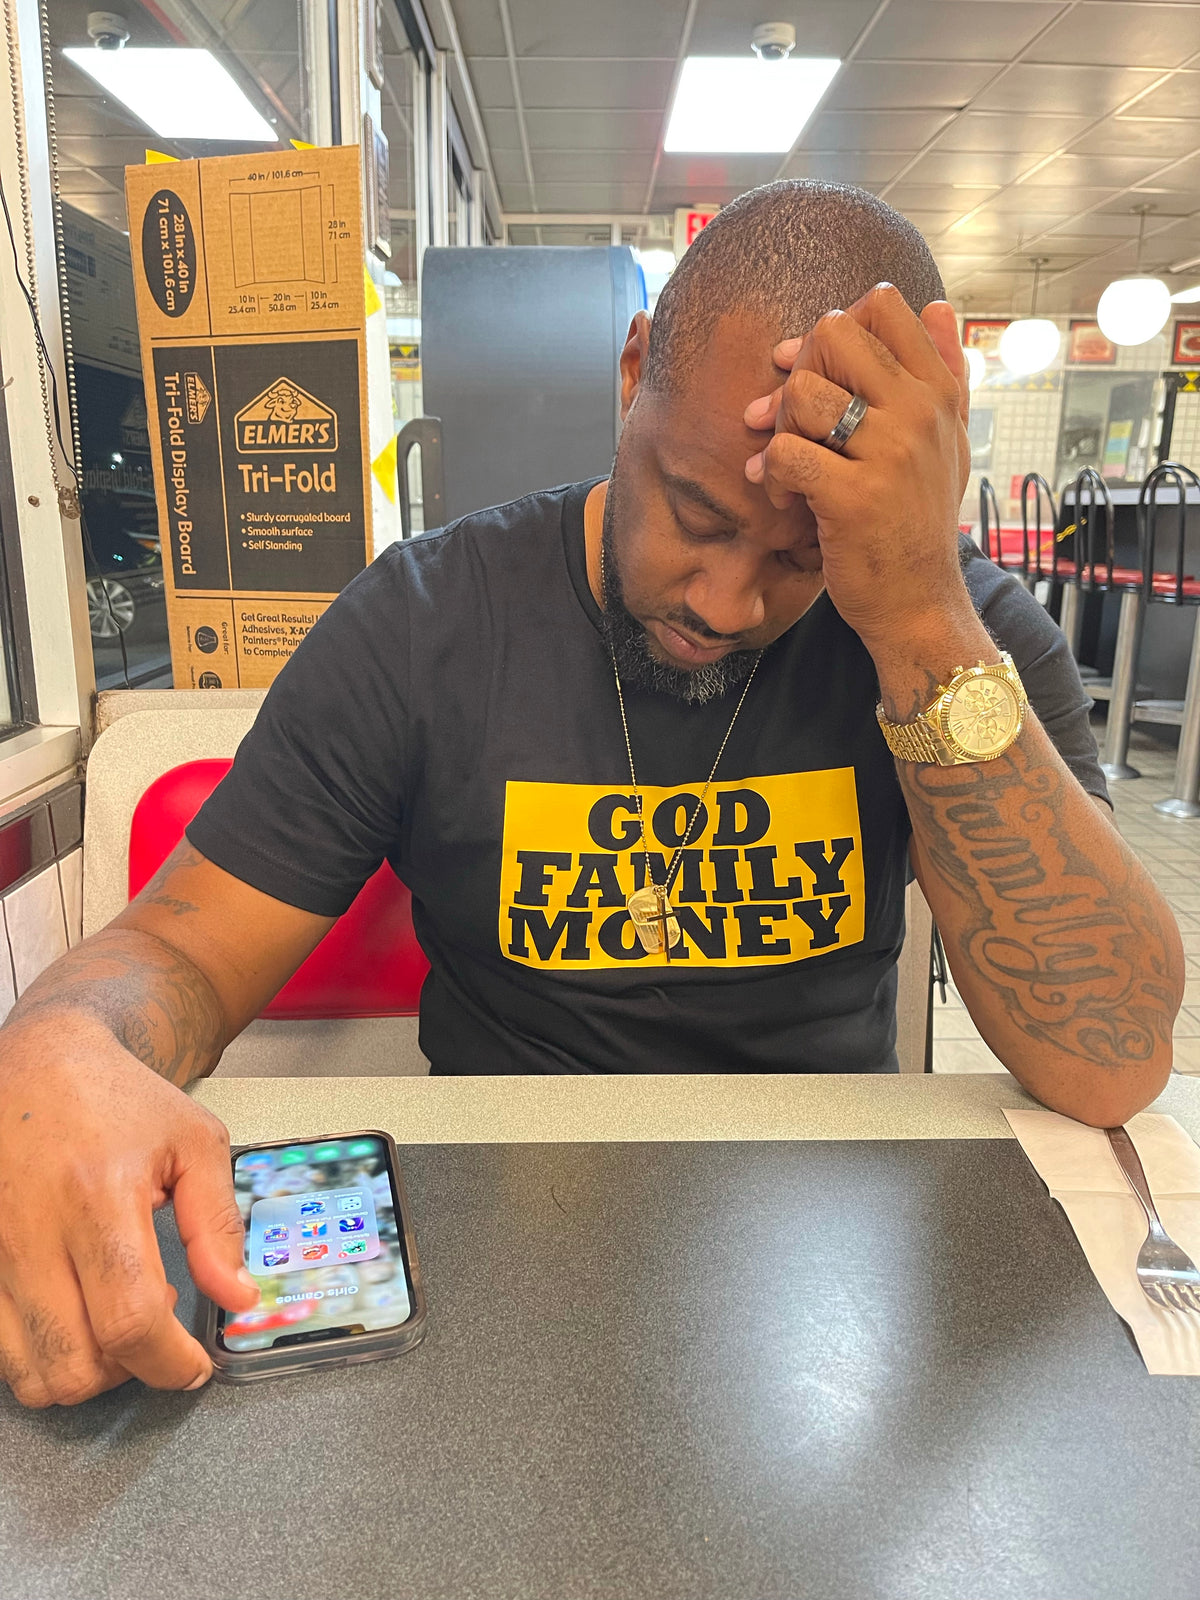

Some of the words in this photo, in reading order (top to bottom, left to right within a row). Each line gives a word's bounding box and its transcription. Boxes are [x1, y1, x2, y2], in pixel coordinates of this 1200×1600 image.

[248, 173, 257, 181] 40
[272, 170, 290, 179] 101.6
[157, 198, 170, 214] 71
[160, 217, 169, 239] cm
[173, 214, 185, 233] 28
[328, 221, 338, 229] 28
[339, 220, 346, 228] in
[175, 234, 185, 248] in
[328, 231, 337, 240] 71
[338, 231, 350, 239] cm
[161, 241, 170, 250] x
[176, 249, 185, 258] x
[162, 252, 175, 288] 101.6
[177, 260, 189, 278] 40
[179, 280, 189, 294] in
[166, 290, 175, 311] cm
[240, 295, 247, 303] 10
[248, 295, 255, 303] in
[273, 293, 283, 301] 20
[284, 293, 291, 301] in
[311, 291, 320, 300] 10
[321, 291, 327, 299] in
[228, 306, 244, 314] 25.4
[268, 303, 285, 312] 50.8
[311, 301, 327, 310] 25.4
[328, 301, 339, 309] cm
[187, 376, 198, 421] ELMER'S
[164, 372, 185, 446] Tri-Fold
[243, 423, 330, 445] ELMER'S
[171, 450, 190, 517] Display
[237, 463, 337, 493] Tri-Fold
[246, 512, 275, 524] Sturdy
[275, 512, 323, 524] corrugated
[324, 512, 351, 522] board
[247, 526, 281, 536] Smooth
[281, 526, 314, 537] surface
[178, 521, 197, 575] Board
[248, 540, 265, 550] Self
[265, 540, 303, 552] Standing
[241, 612, 256, 622] Get
[256, 612, 280, 623] Great
[281, 613, 315, 624] Results!
[242, 624, 288, 636] Adhesives,
[282, 637, 303, 647] Pain
[243, 647, 252, 656] to
[587, 788, 771, 852] GOD
[512, 836, 855, 908] FAMILY
[508, 894, 852, 961] MONEY
[327, 1285, 359, 1297] Girls
[275, 1291, 325, 1304] Games
